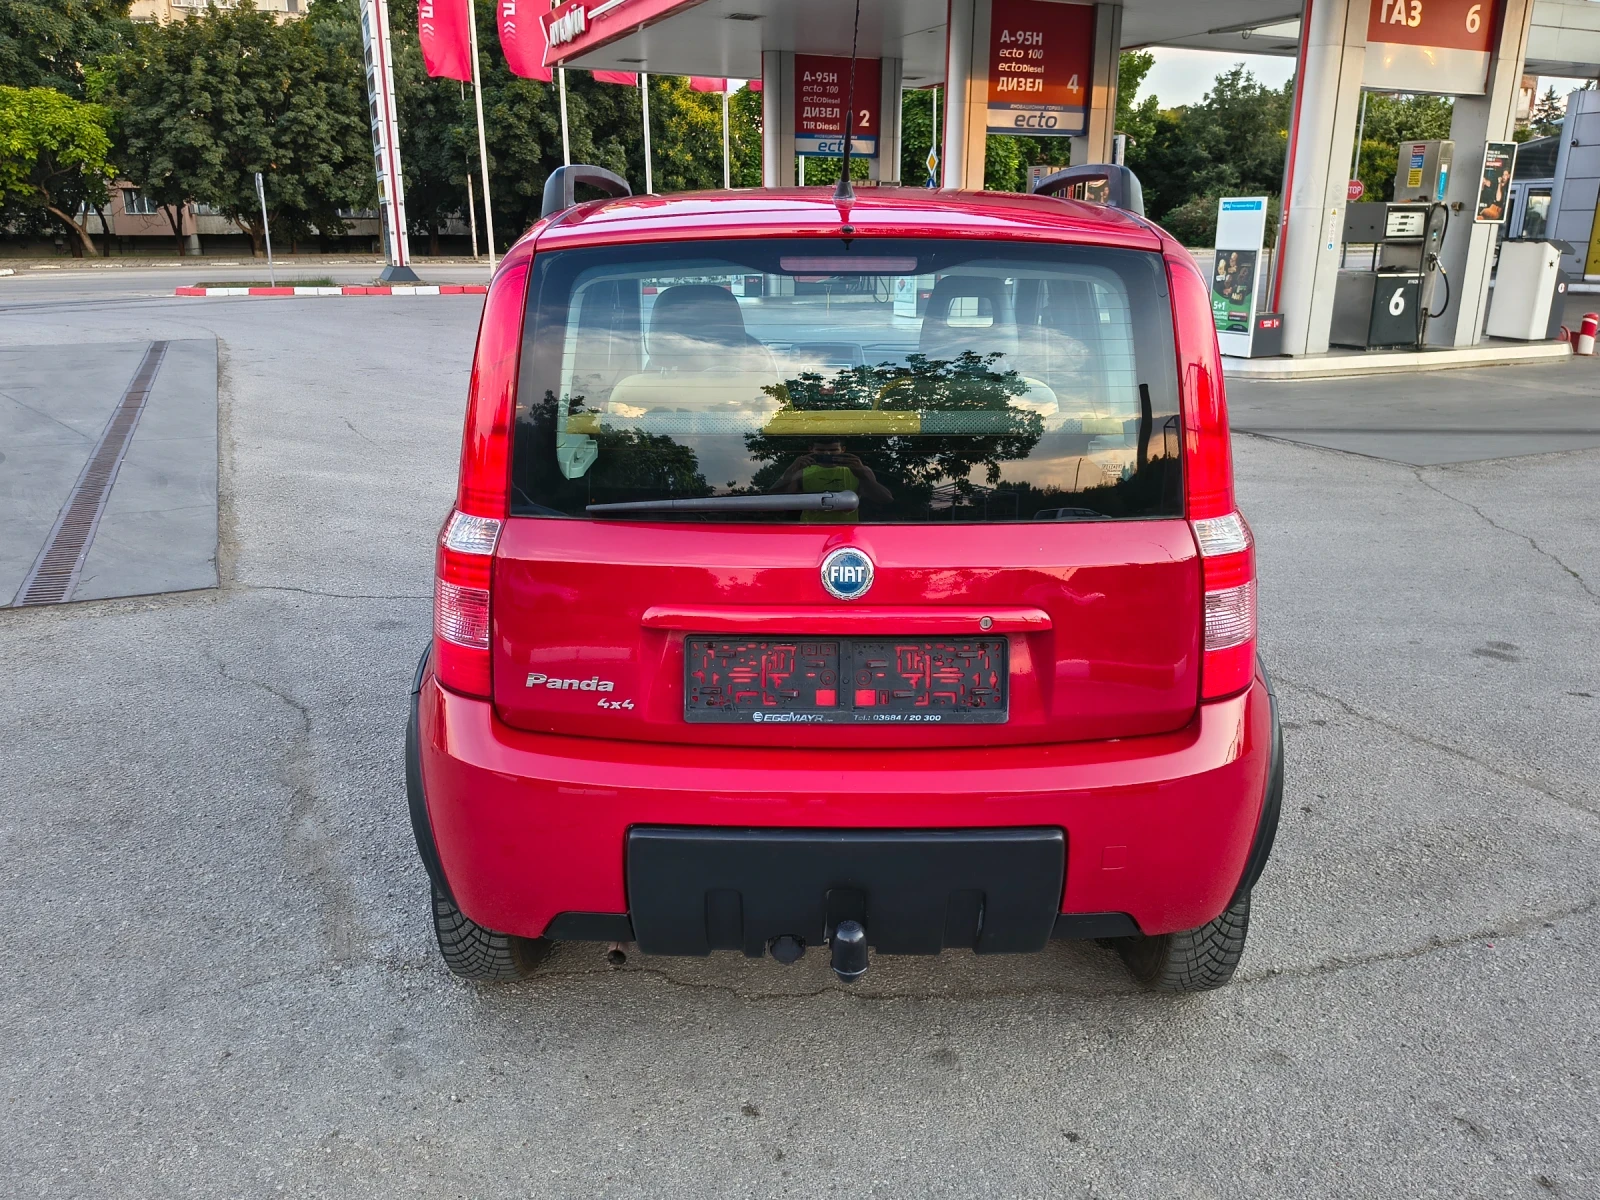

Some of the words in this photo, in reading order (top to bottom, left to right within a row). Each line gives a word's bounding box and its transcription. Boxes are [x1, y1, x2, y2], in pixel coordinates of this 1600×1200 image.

[1380, 0, 1422, 27] ГАЗ
[1466, 4, 1481, 34] 6
[999, 48, 1024, 58] ecto
[1028, 49, 1044, 59] 100
[802, 84, 822, 92] ecto
[826, 86, 838, 94] 100
[997, 77, 1043, 92] ДИЗЕЛ
[1066, 74, 1079, 94] 4
[803, 106, 840, 118] ДИЗЕЛ
[859, 110, 870, 127] 2
[803, 121, 816, 129] TIR
[816, 122, 840, 130] Diesel
[1014, 112, 1058, 128] ecto
[1348, 186, 1362, 195] TOP
[1213, 301, 1226, 310] 5+1
[1389, 288, 1404, 316] 6
[830, 566, 864, 582] FIAT
[526, 672, 614, 692] Panda
[597, 698, 634, 710] 4x4
